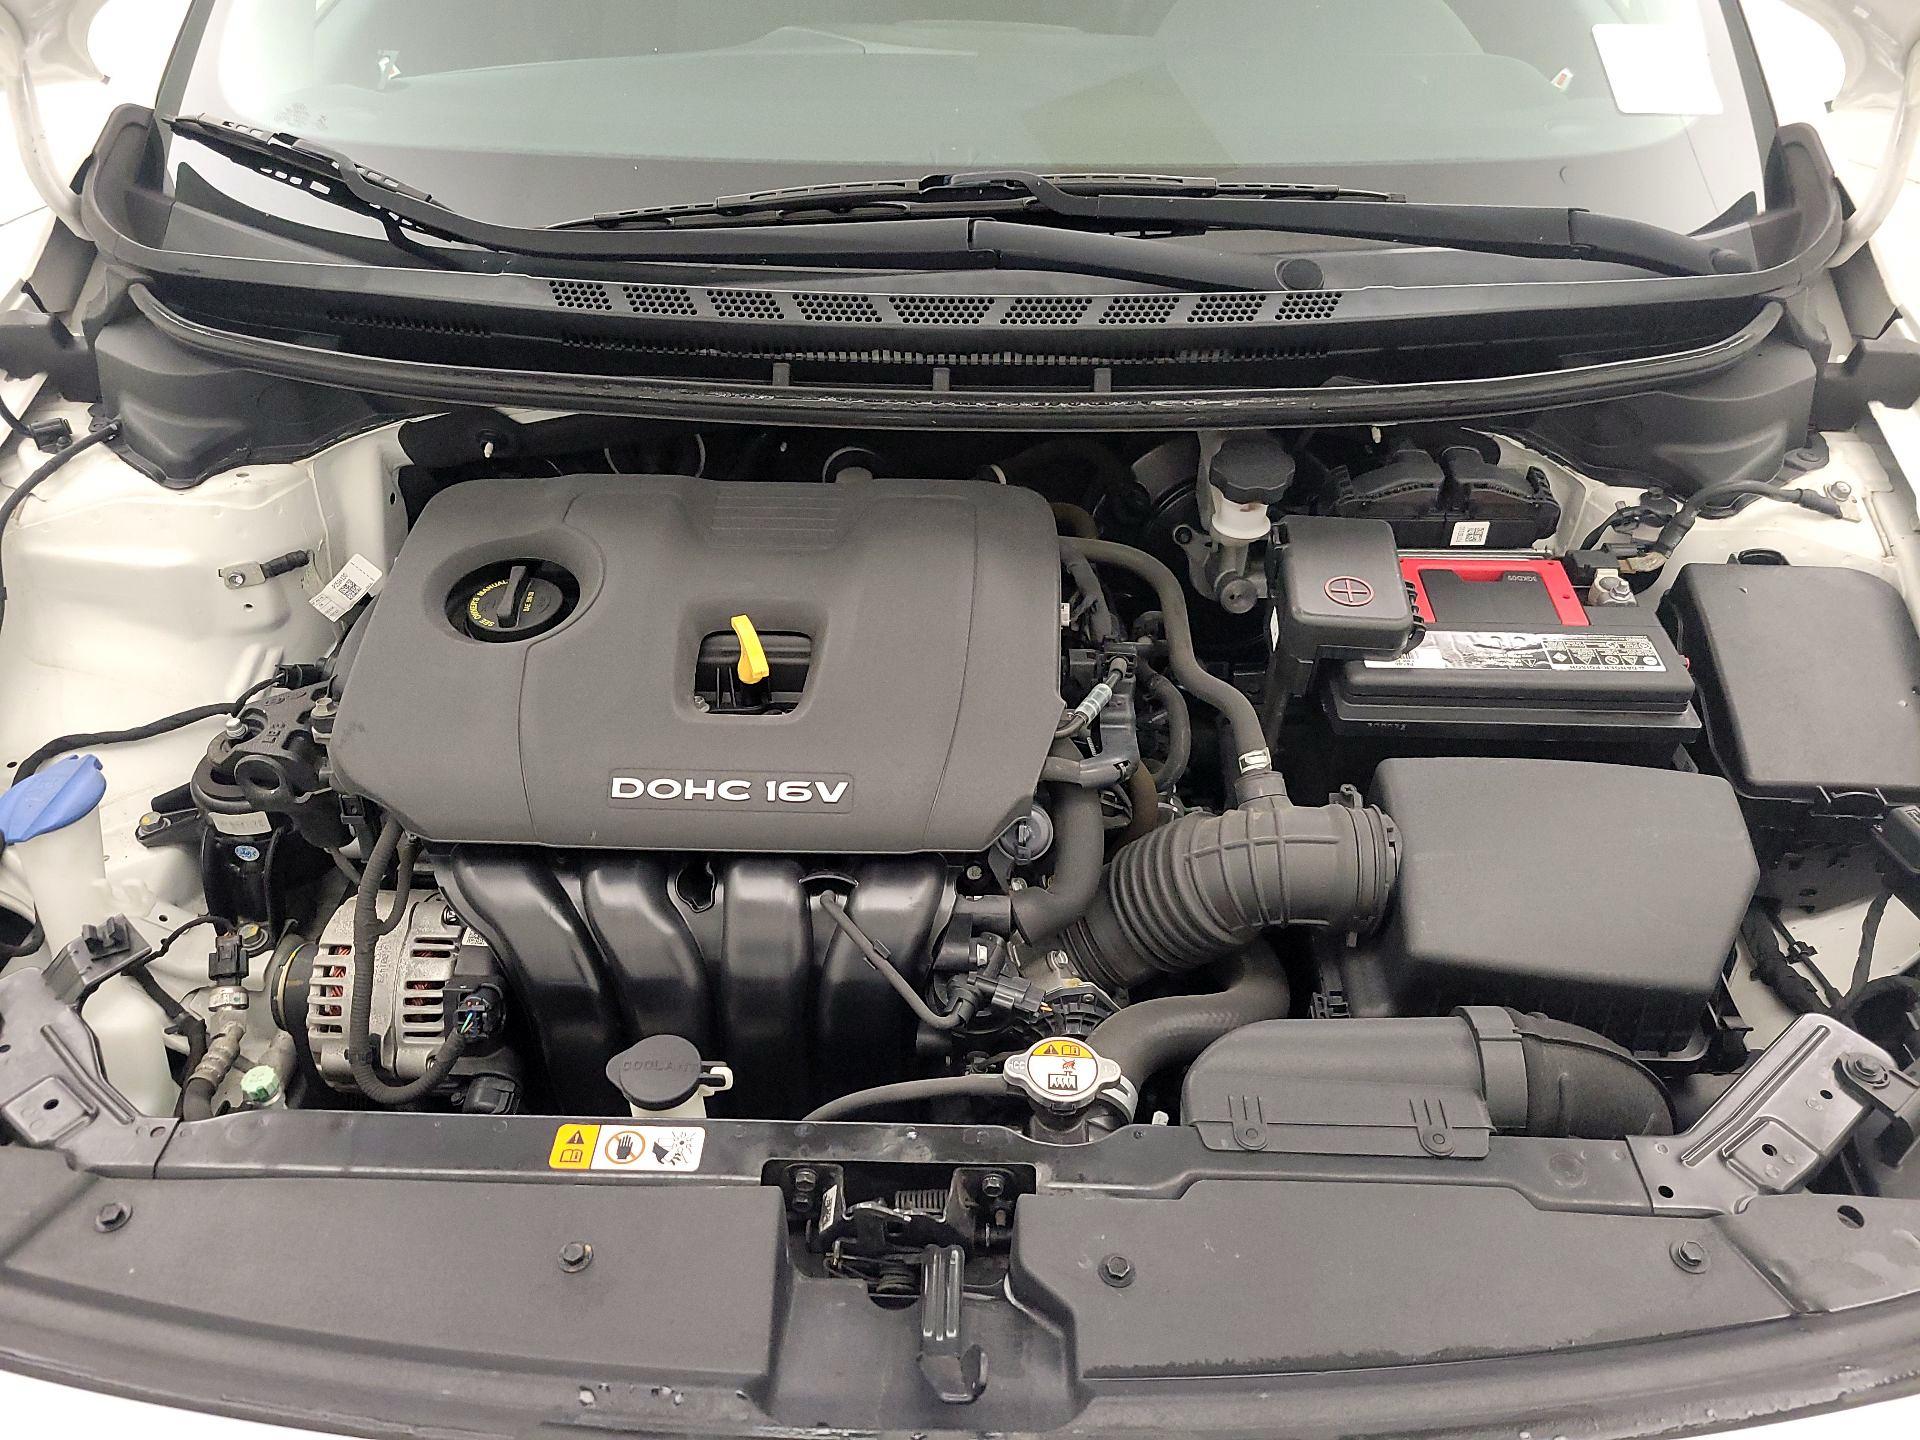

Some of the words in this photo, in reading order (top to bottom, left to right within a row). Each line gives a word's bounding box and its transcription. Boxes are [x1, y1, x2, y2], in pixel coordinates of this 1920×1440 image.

[477, 580, 508, 597] MANUAL
[479, 618, 495, 627] SEE
[611, 777, 751, 801] DOHC
[765, 780, 849, 803] 16V
[623, 1060, 702, 1075] COOLANT
